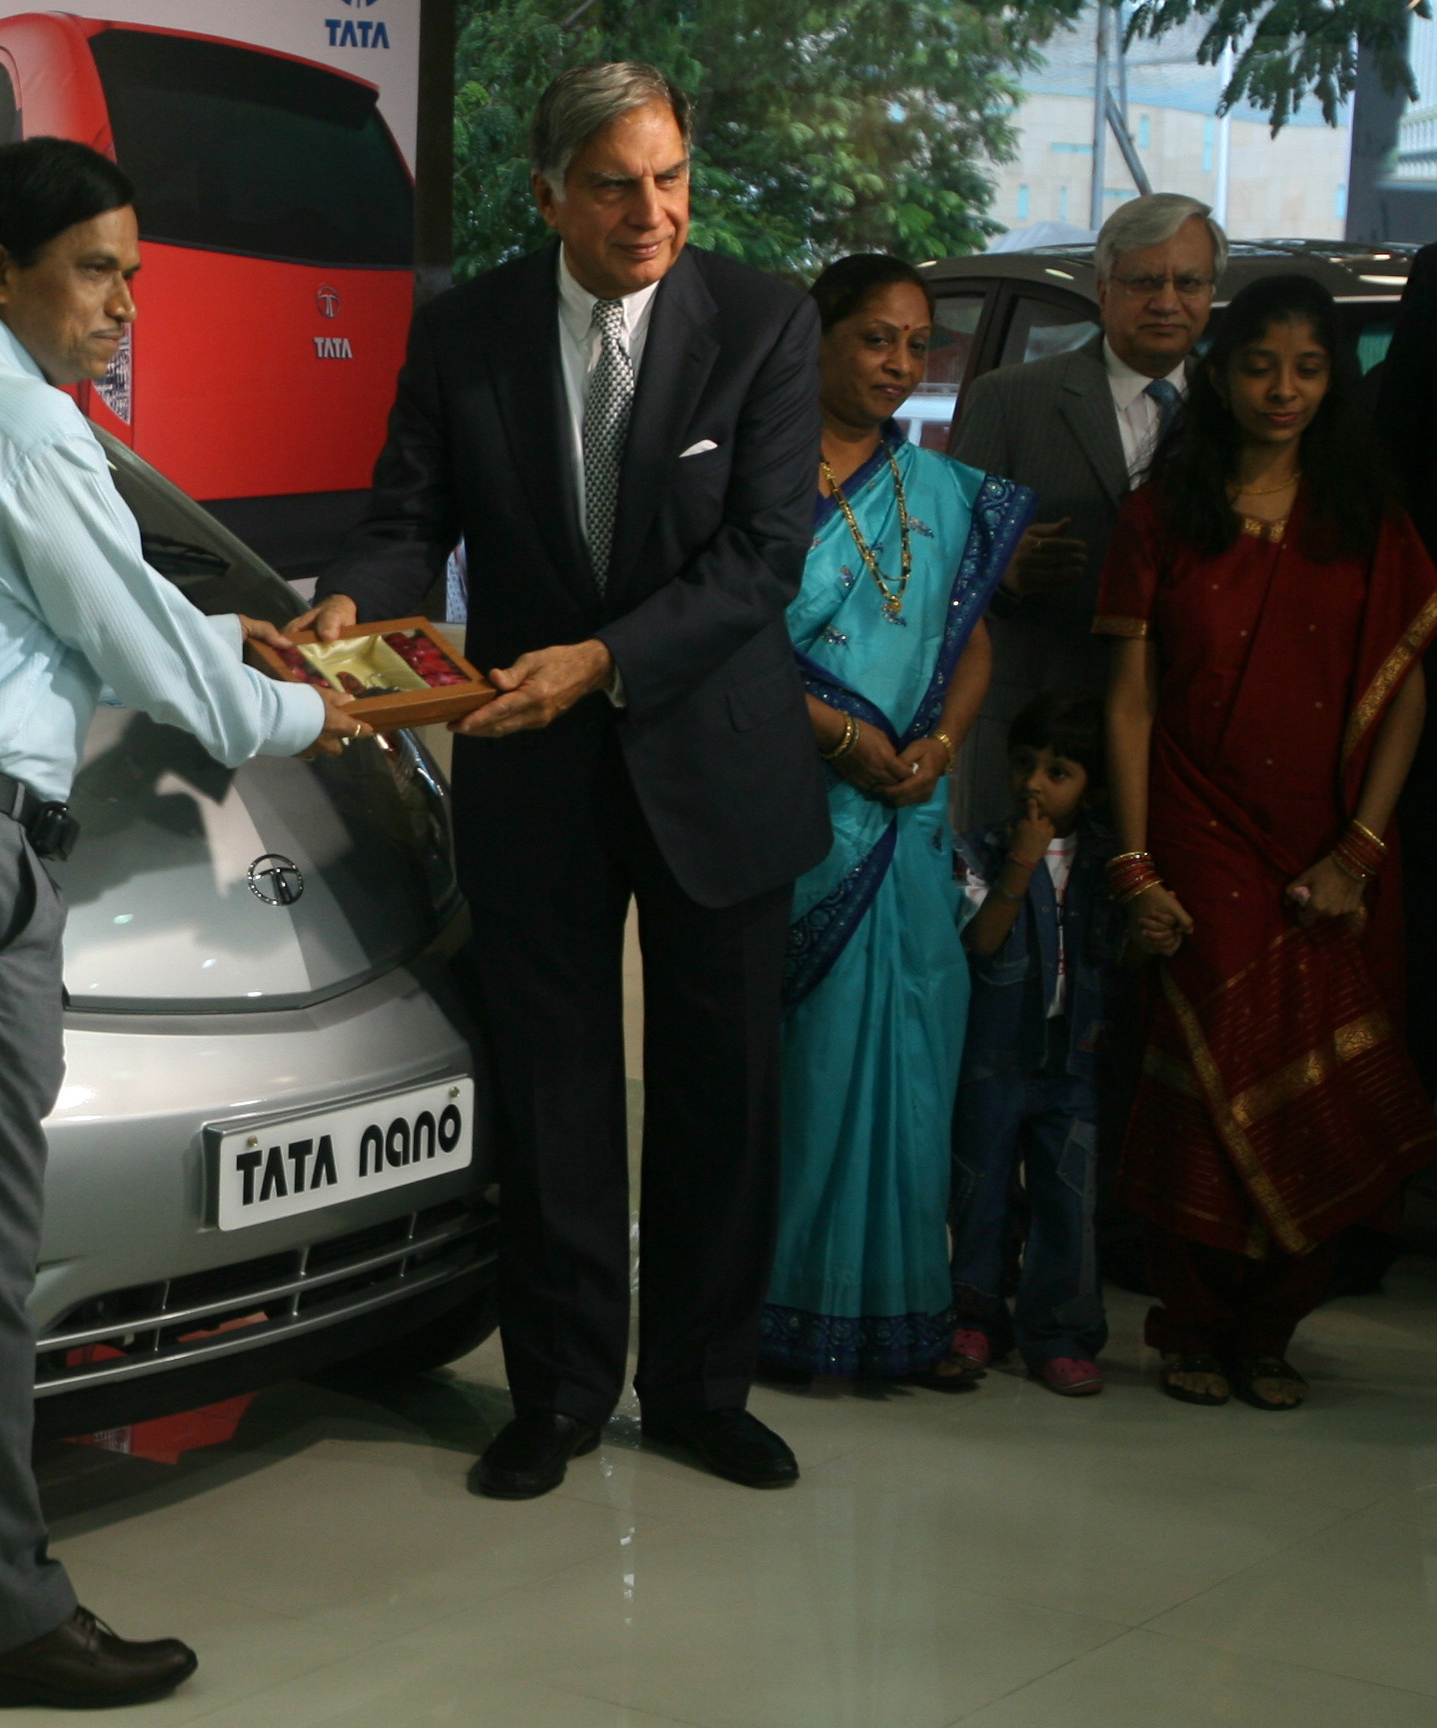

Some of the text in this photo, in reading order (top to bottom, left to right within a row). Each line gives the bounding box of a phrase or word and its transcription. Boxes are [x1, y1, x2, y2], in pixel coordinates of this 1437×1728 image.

[325, 19, 390, 49] TATA
[314, 336, 354, 359] TATA
[236, 1103, 462, 1206] TATA nano
